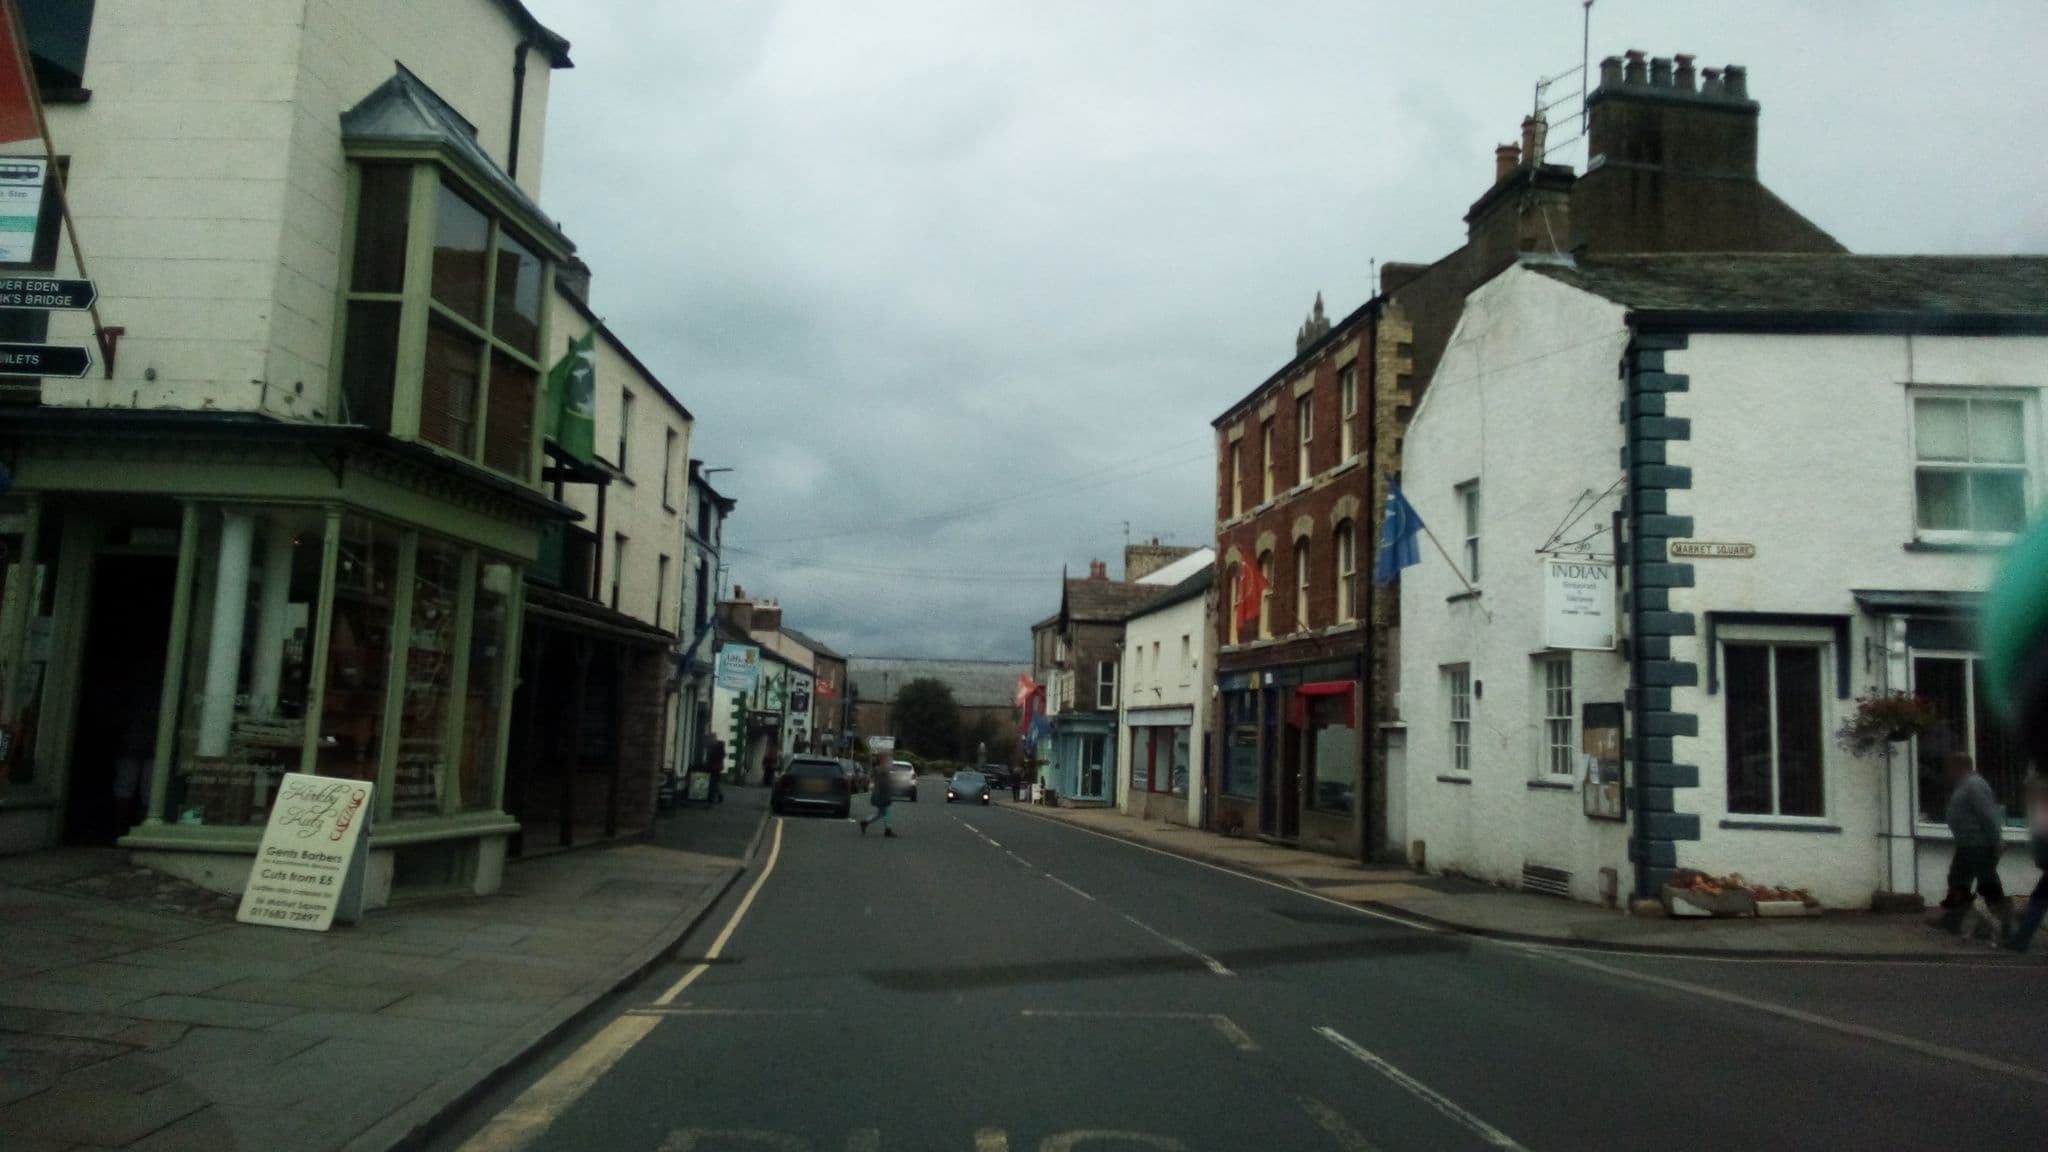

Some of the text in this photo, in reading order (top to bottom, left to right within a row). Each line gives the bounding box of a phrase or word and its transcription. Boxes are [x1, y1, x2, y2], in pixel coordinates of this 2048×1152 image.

[26, 281, 60, 292] EDEN
[0, 293, 72, 306] K'S BRIDGE
[1675, 543, 1751, 555] MARKET SQUARE
[1552, 564, 1608, 580] INDIAN
[266, 846, 342, 863] Gents Barbers
[262, 868, 287, 881] Cuts
[289, 871, 316, 883] from
